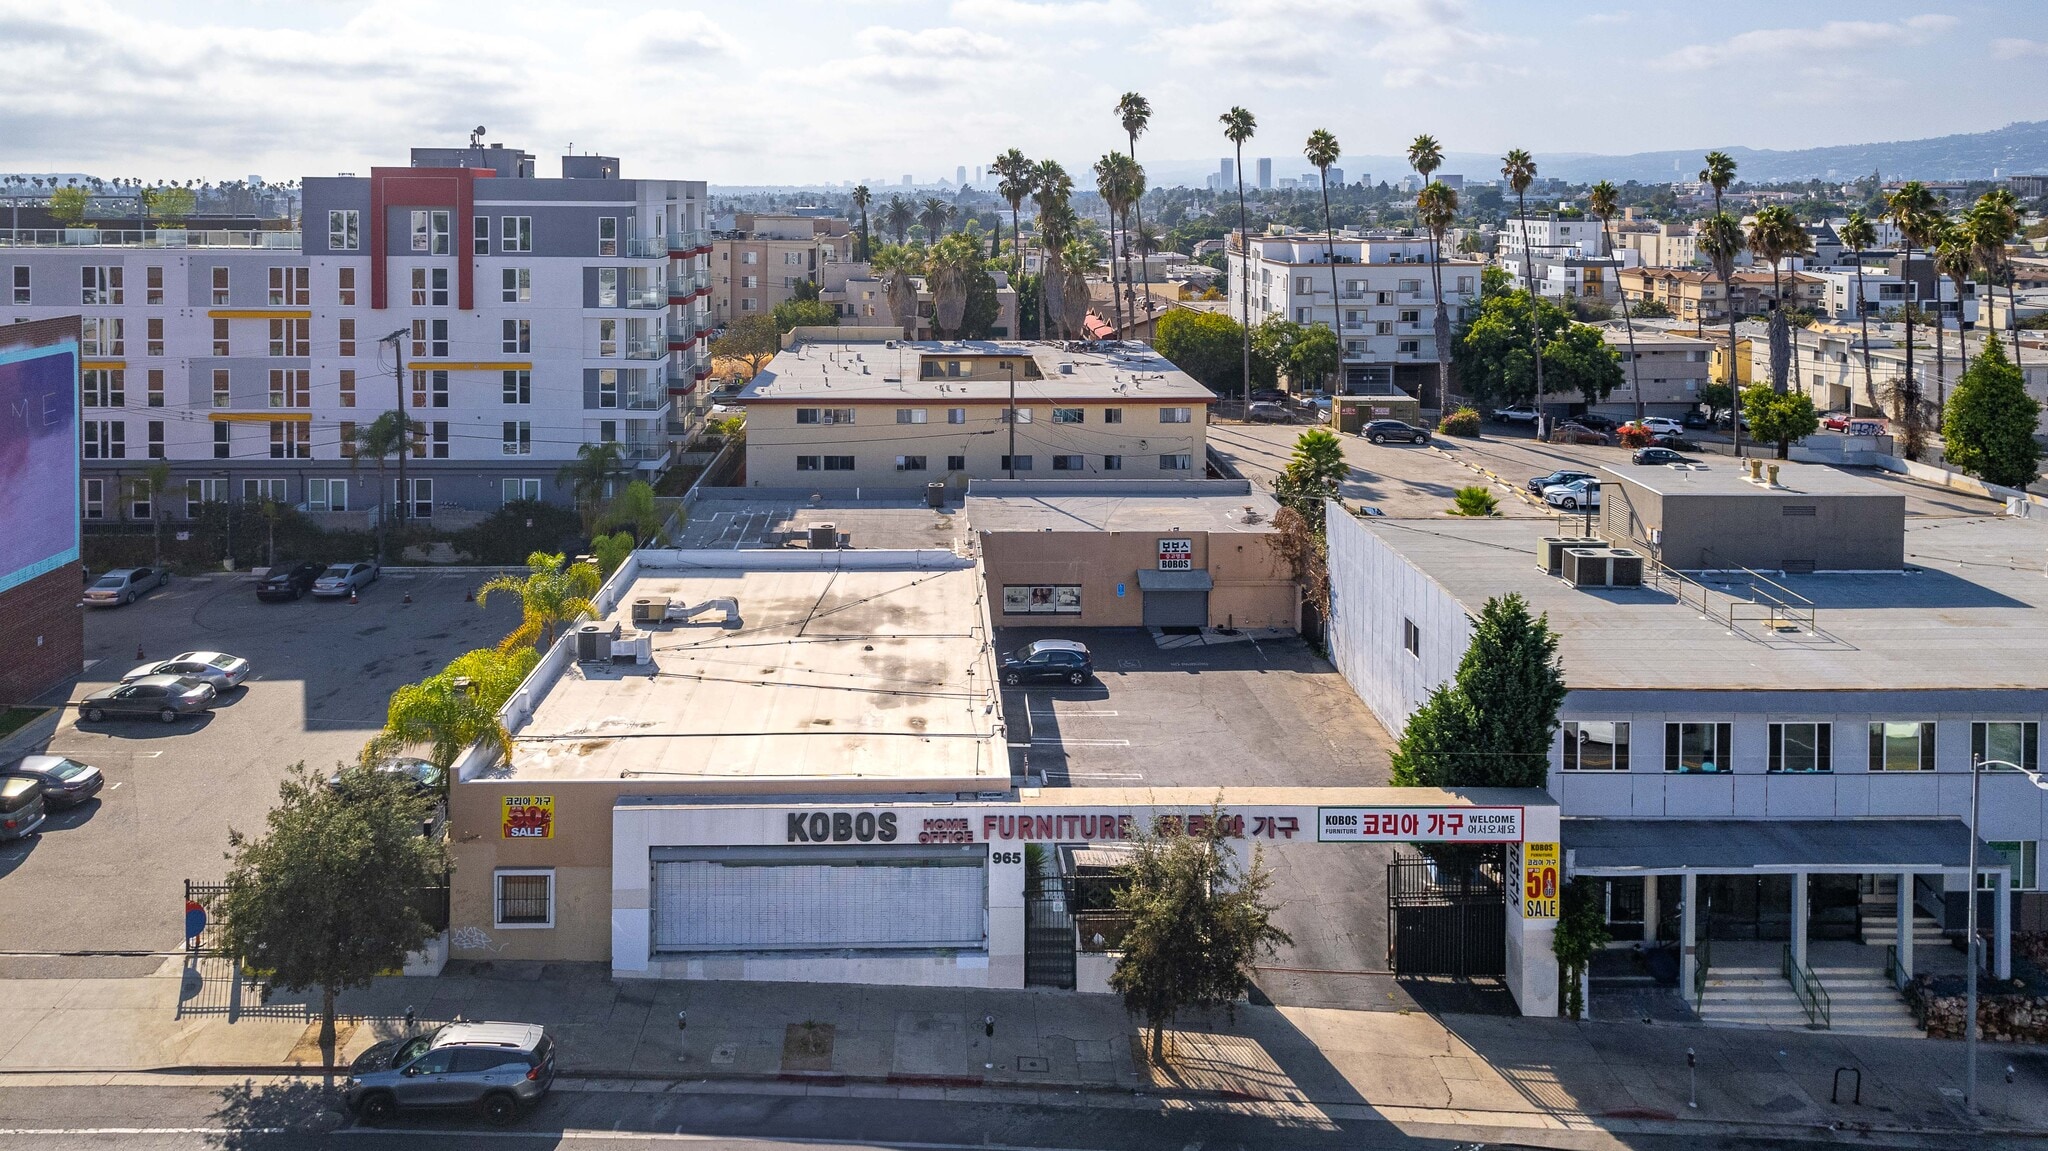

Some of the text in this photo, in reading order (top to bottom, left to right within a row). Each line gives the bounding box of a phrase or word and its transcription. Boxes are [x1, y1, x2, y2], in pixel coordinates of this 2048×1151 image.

[1162, 541, 1189, 553] 보보스
[1162, 560, 1189, 569] BOBOS
[505, 797, 551, 806] 코리아 가구
[923, 818, 969, 831] HOME
[1325, 815, 1358, 826] KOBOS
[1363, 814, 1464, 836] 코리아 가구
[1469, 815, 1516, 824] WELCOME
[511, 827, 543, 837] SALE
[787, 811, 898, 843] KOBOS
[983, 814, 1133, 841] FURNITURE
[1252, 816, 1300, 839] 가구
[1468, 824, 1517, 835] 어서오세요
[918, 830, 974, 844] OFFICE
[992, 852, 1022, 865] 965
[1527, 900, 1556, 917] SALE
